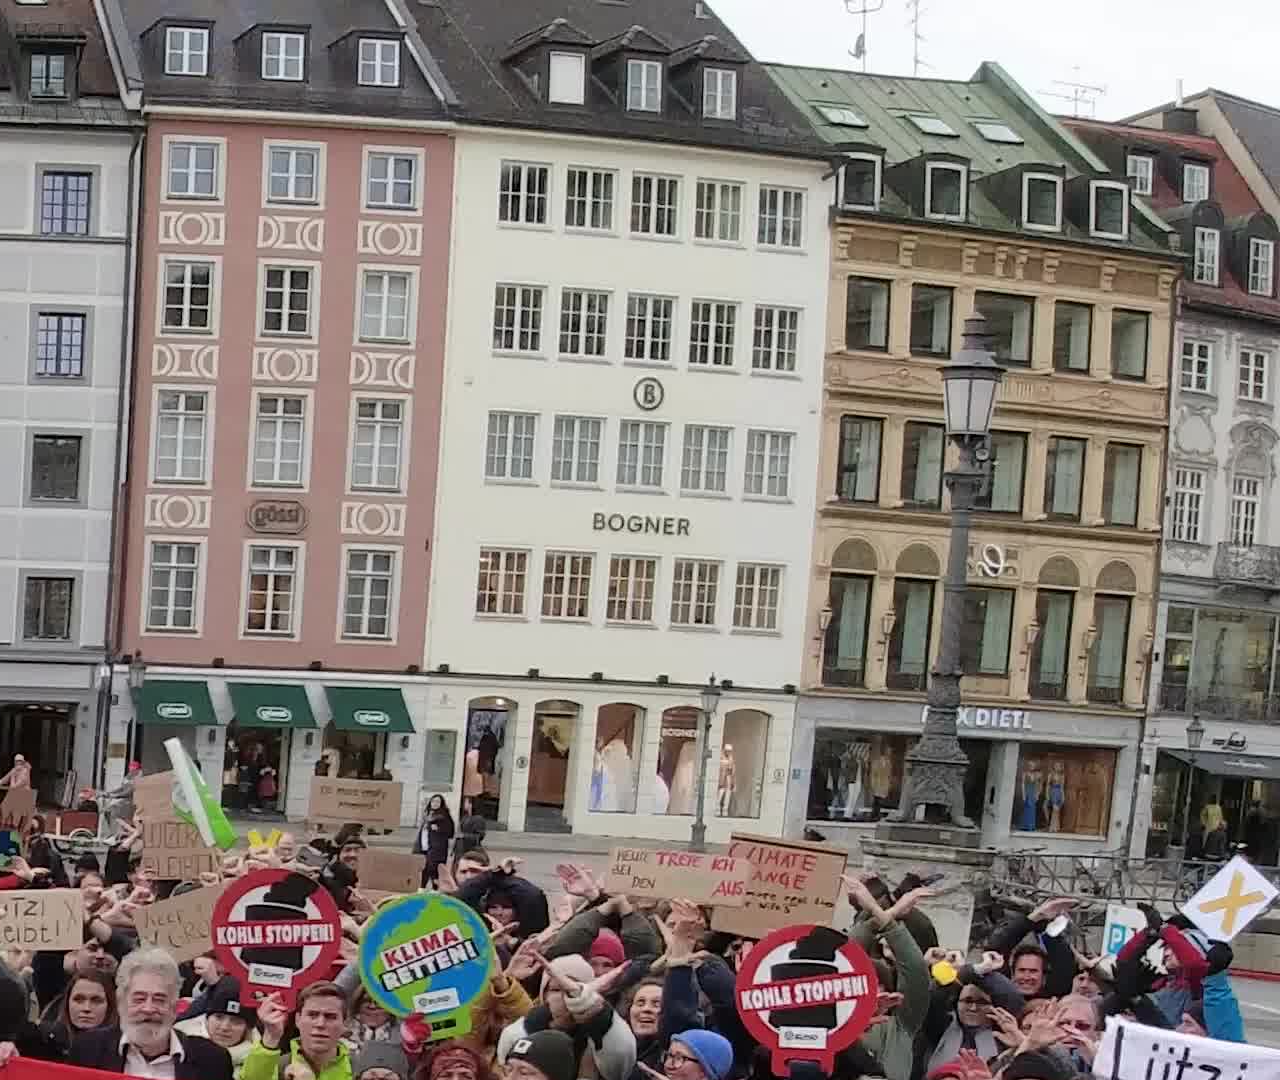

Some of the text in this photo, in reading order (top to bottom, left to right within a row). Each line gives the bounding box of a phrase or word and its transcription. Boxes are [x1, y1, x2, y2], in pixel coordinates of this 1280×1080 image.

[593, 512, 690, 536] BOGNER
[976, 709, 1032, 728] DIETL
[713, 880, 744, 897] AUS
[216, 924, 334, 944] KOHLE STOPPEN!
[385, 927, 460, 968] KLIMA
[382, 944, 479, 991] RETTEN!
[740, 975, 869, 1010] KOHLE STOPPEN!
